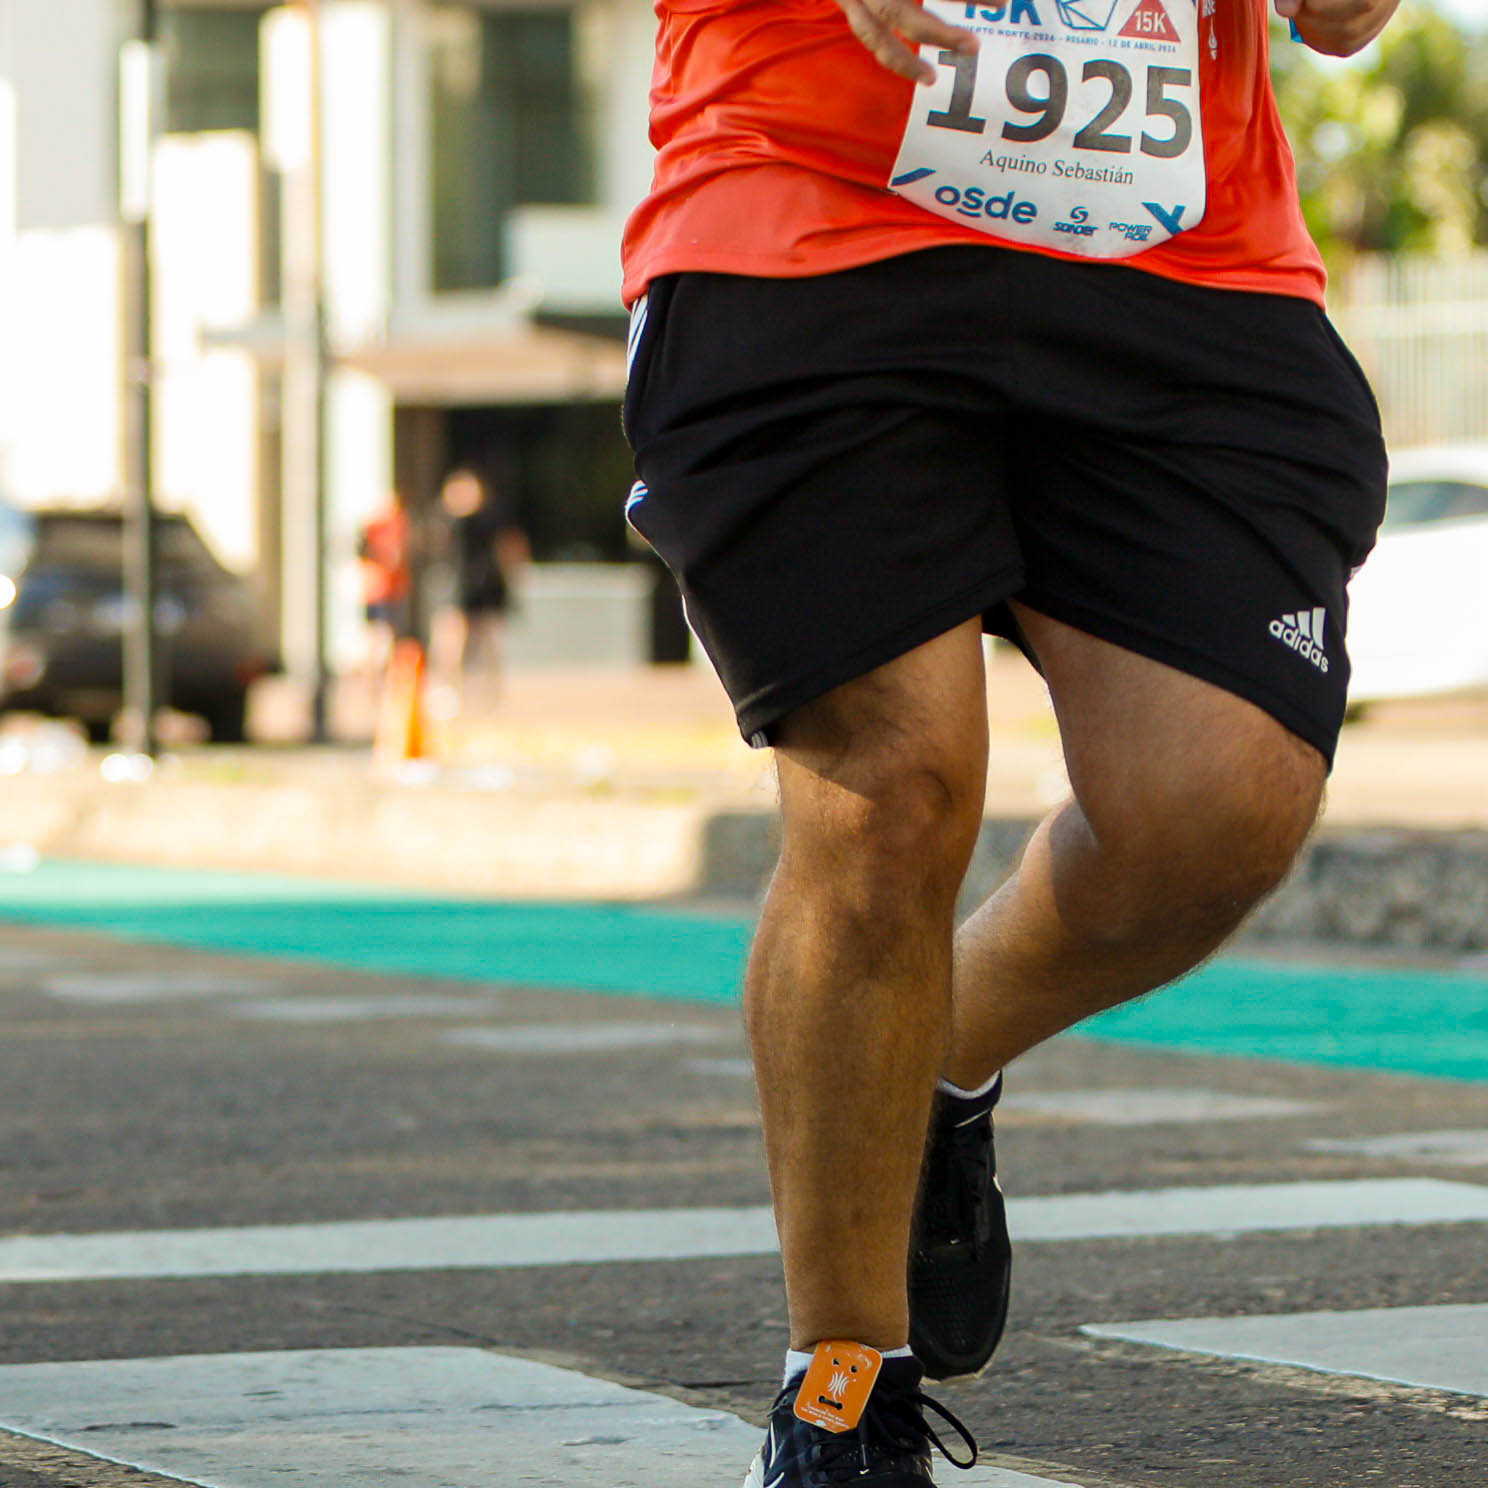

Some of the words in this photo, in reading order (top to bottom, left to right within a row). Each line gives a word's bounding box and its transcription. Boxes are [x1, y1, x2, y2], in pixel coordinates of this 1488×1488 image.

[1134, 10, 1167, 34] 15K
[1121, 40, 1131, 49] DE
[926, 50, 1193, 158] 1925
[979, 149, 1048, 176] Aquino
[1051, 160, 1135, 185] Sebastián
[934, 185, 1038, 225] osde
[1109, 221, 1152, 234] POWER
[1268, 619, 1329, 672] adidas
